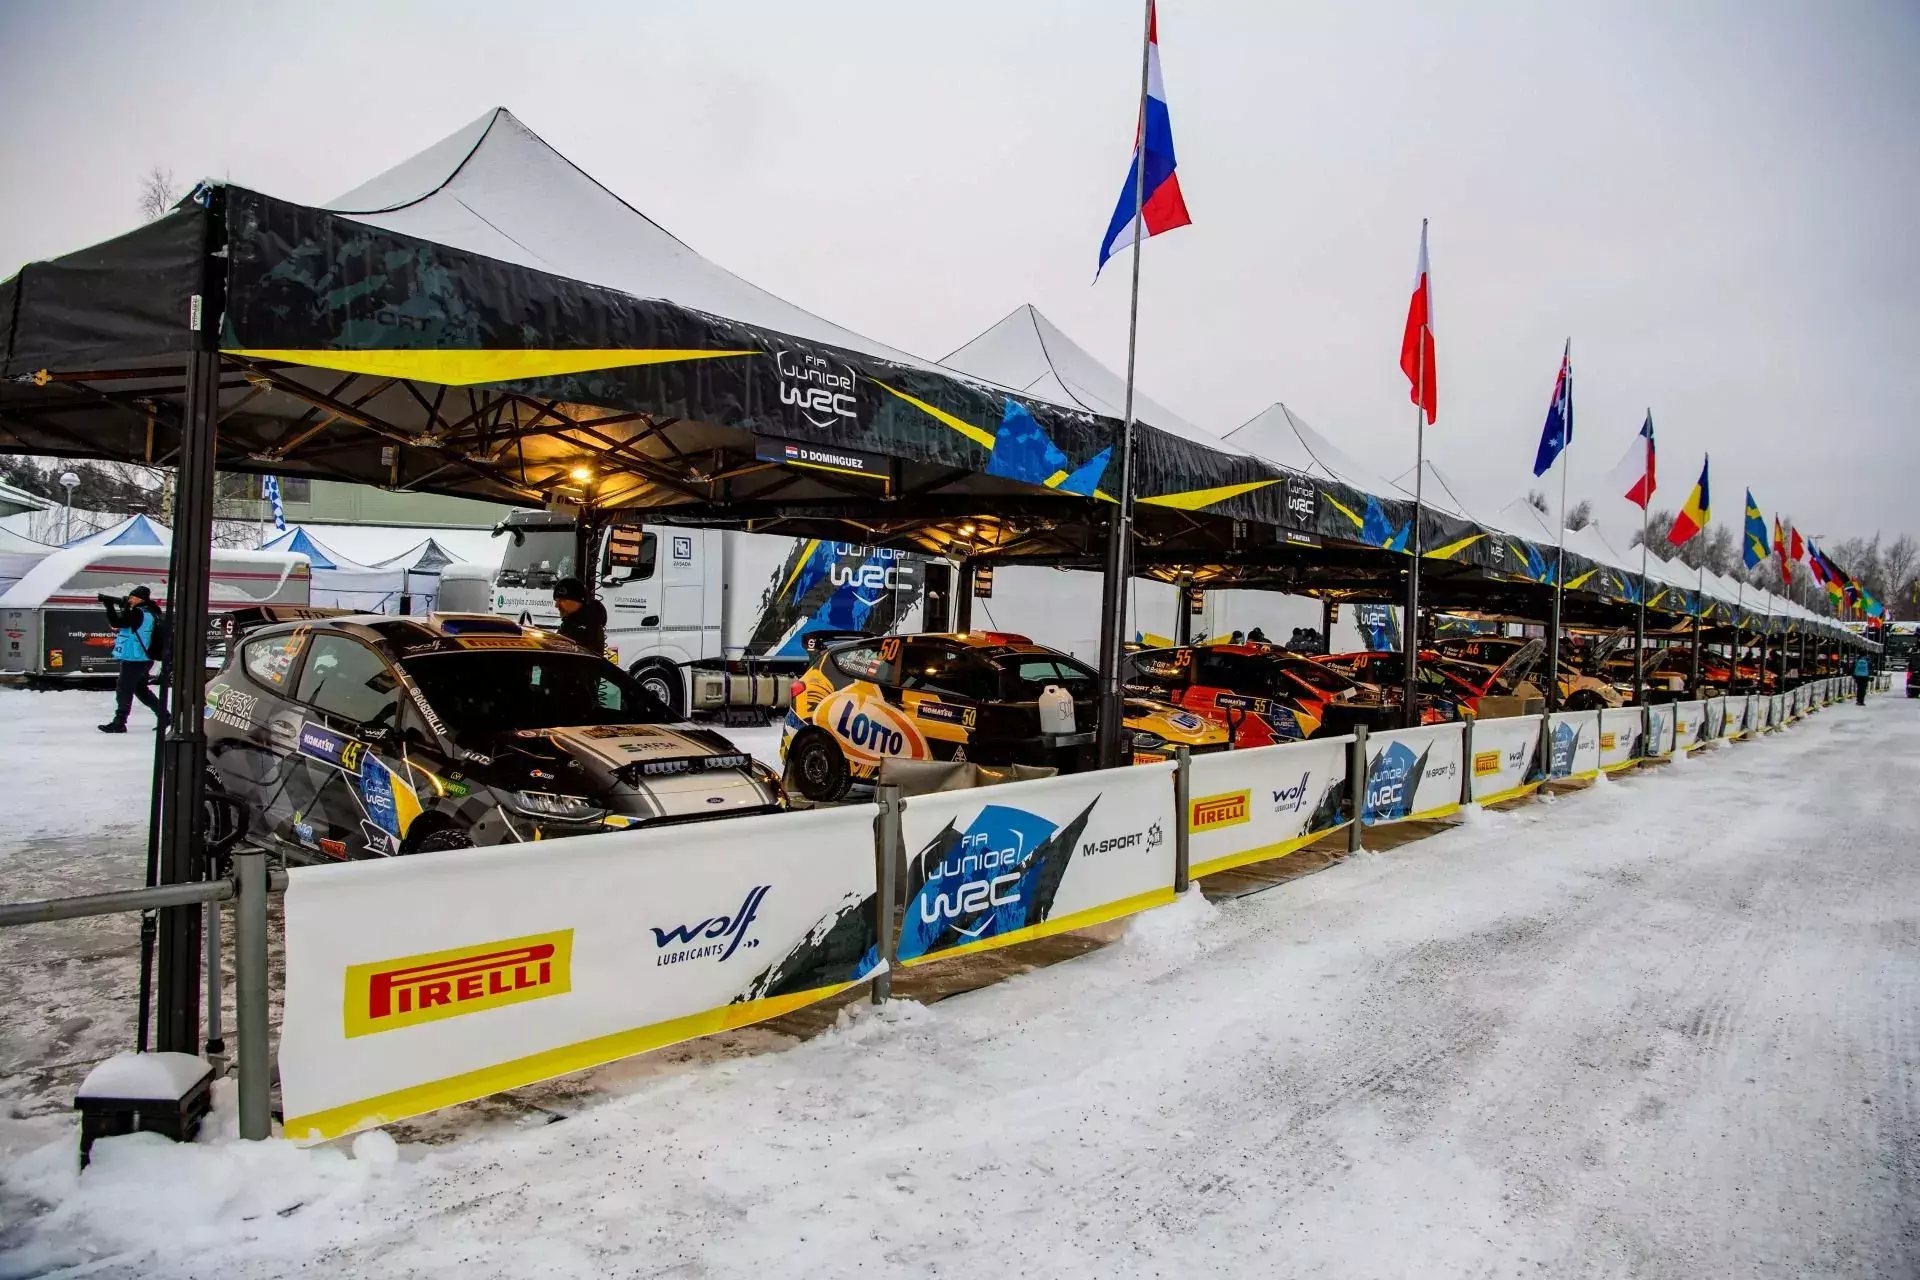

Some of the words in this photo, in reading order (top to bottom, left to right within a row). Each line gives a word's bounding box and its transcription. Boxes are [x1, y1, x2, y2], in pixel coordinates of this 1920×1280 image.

[805, 355, 827, 368] FIA
[784, 365, 851, 390] JUNIOR
[779, 381, 857, 418] WRC
[800, 449, 808, 460] D
[809, 450, 864, 469] DOMINGUEZ
[830, 562, 914, 590] WRC
[1360, 611, 1387, 628] WRC
[68, 631, 87, 639] rally
[876, 639, 900, 662] 50
[1174, 649, 1193, 667] 55
[1466, 642, 1480, 656] 46
[922, 705, 953, 718] KOMATSU
[961, 707, 977, 727] 50
[1253, 699, 1267, 713] 55
[836, 699, 903, 756] LOTTO
[303, 733, 335, 753] KOMATSU
[341, 740, 362, 771] 45
[1475, 754, 1499, 773] PIRELLI
[1272, 771, 1311, 813] wolf
[1367, 783, 1403, 809] WRC
[1193, 795, 1246, 827] PIRELLI
[961, 832, 988, 849] FIA
[1082, 832, 1143, 858] M-SPORT
[928, 847, 1015, 881] JUNIOR
[921, 872, 1021, 924] WRC
[649, 885, 772, 962] wolf
[656, 943, 724, 966] LUBRICANTS
[369, 943, 555, 1019] PIRELLI
